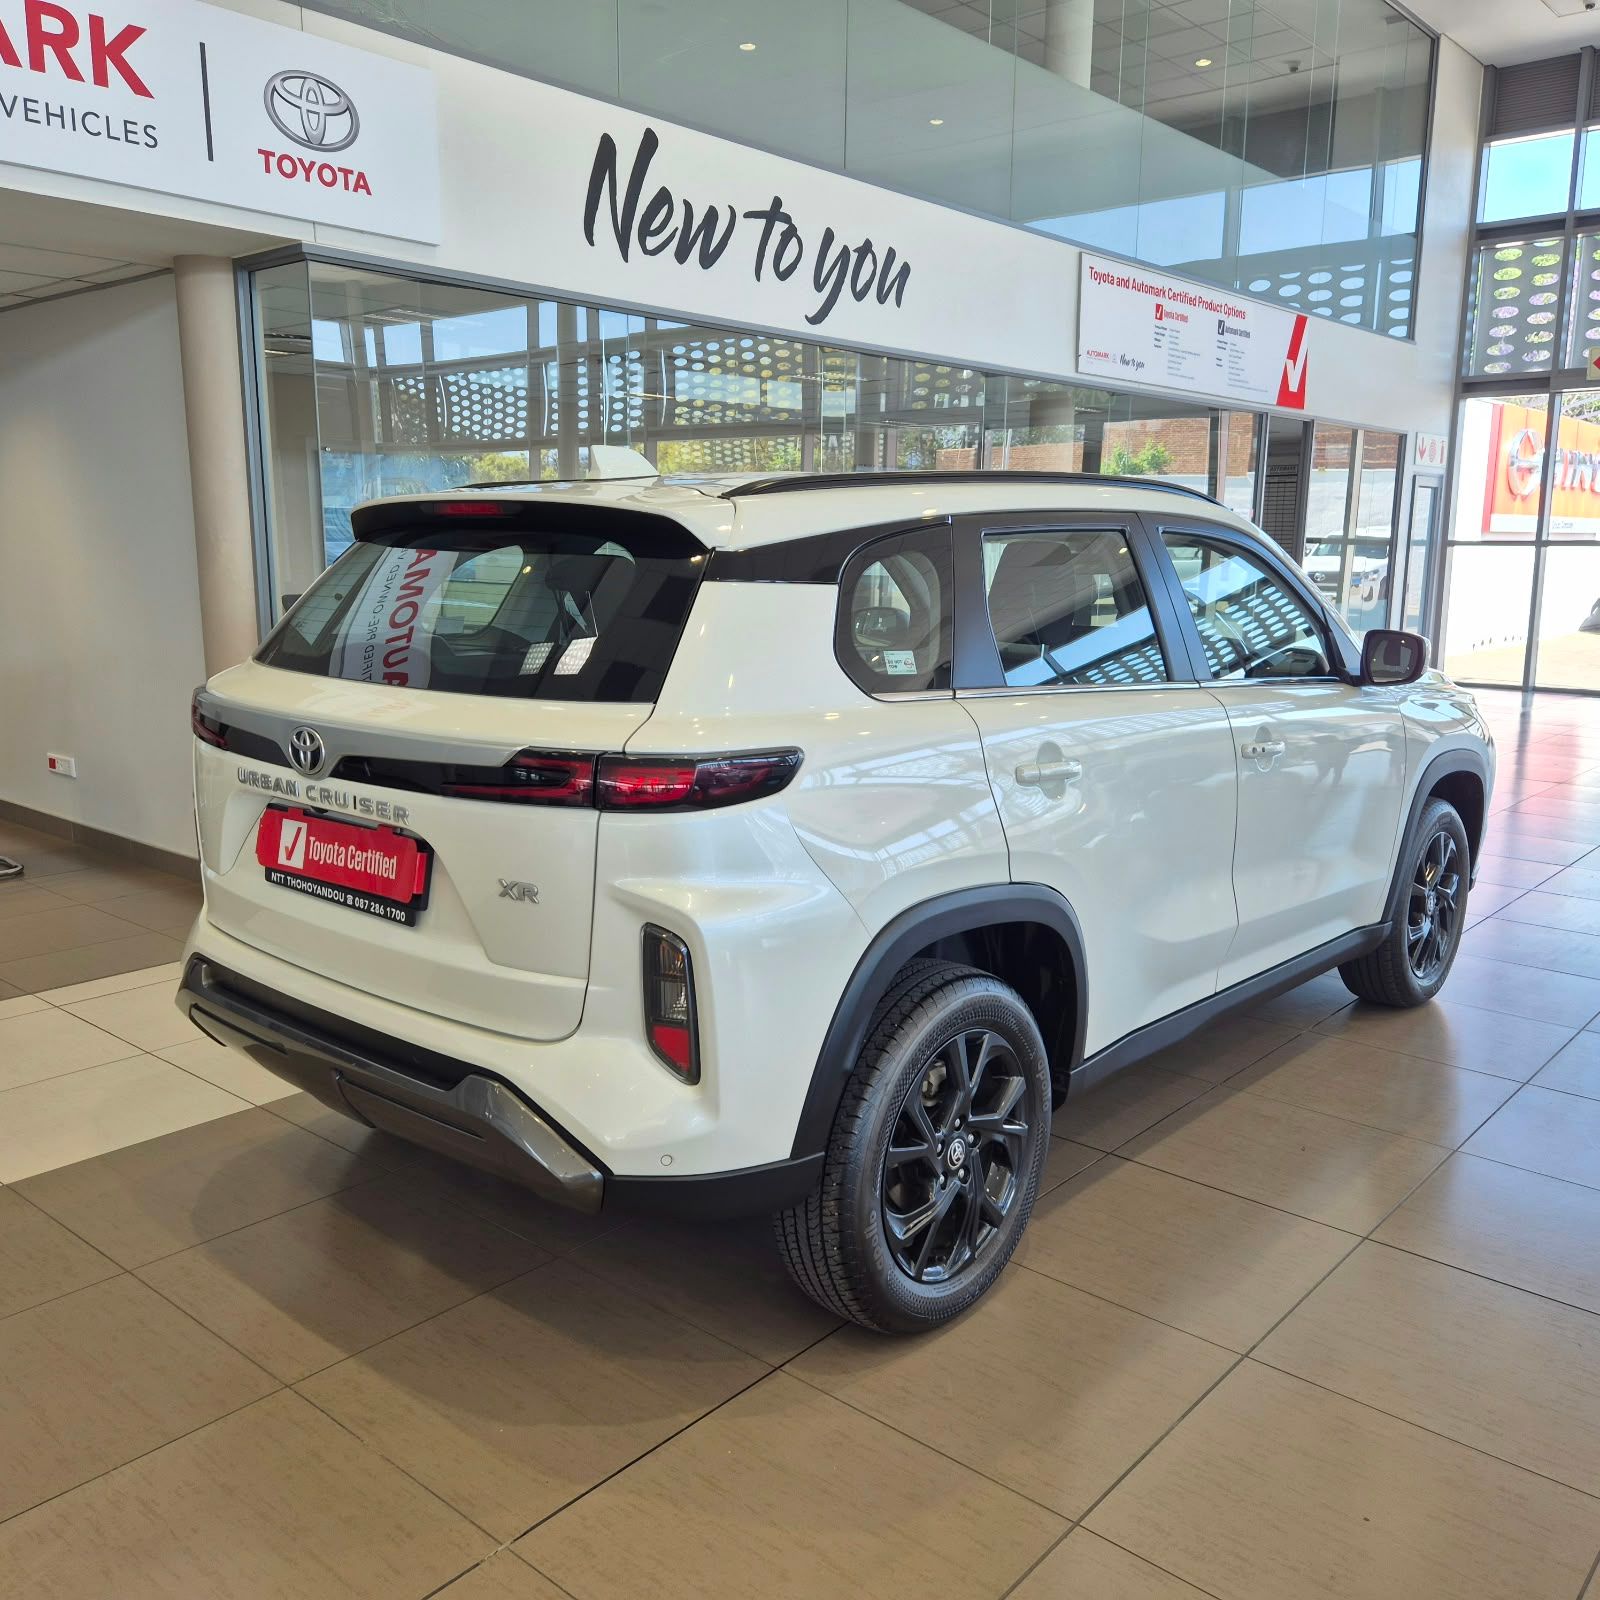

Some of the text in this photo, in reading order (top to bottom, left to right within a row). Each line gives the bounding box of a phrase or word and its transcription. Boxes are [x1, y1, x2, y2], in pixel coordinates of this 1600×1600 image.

[0, 93, 158, 149] VEHICLES
[258, 148, 372, 196] TOYOTA
[584, 128, 911, 325] New to you
[1089, 266, 1246, 320] Toyota and Automark Certified Product Options
[238, 767, 410, 826] URBAN CRUISER
[309, 837, 398, 880] Toyota Certified
[271, 871, 406, 922] NTT THOHOYANDOU 087 286 1700
[498, 878, 540, 904] XR
